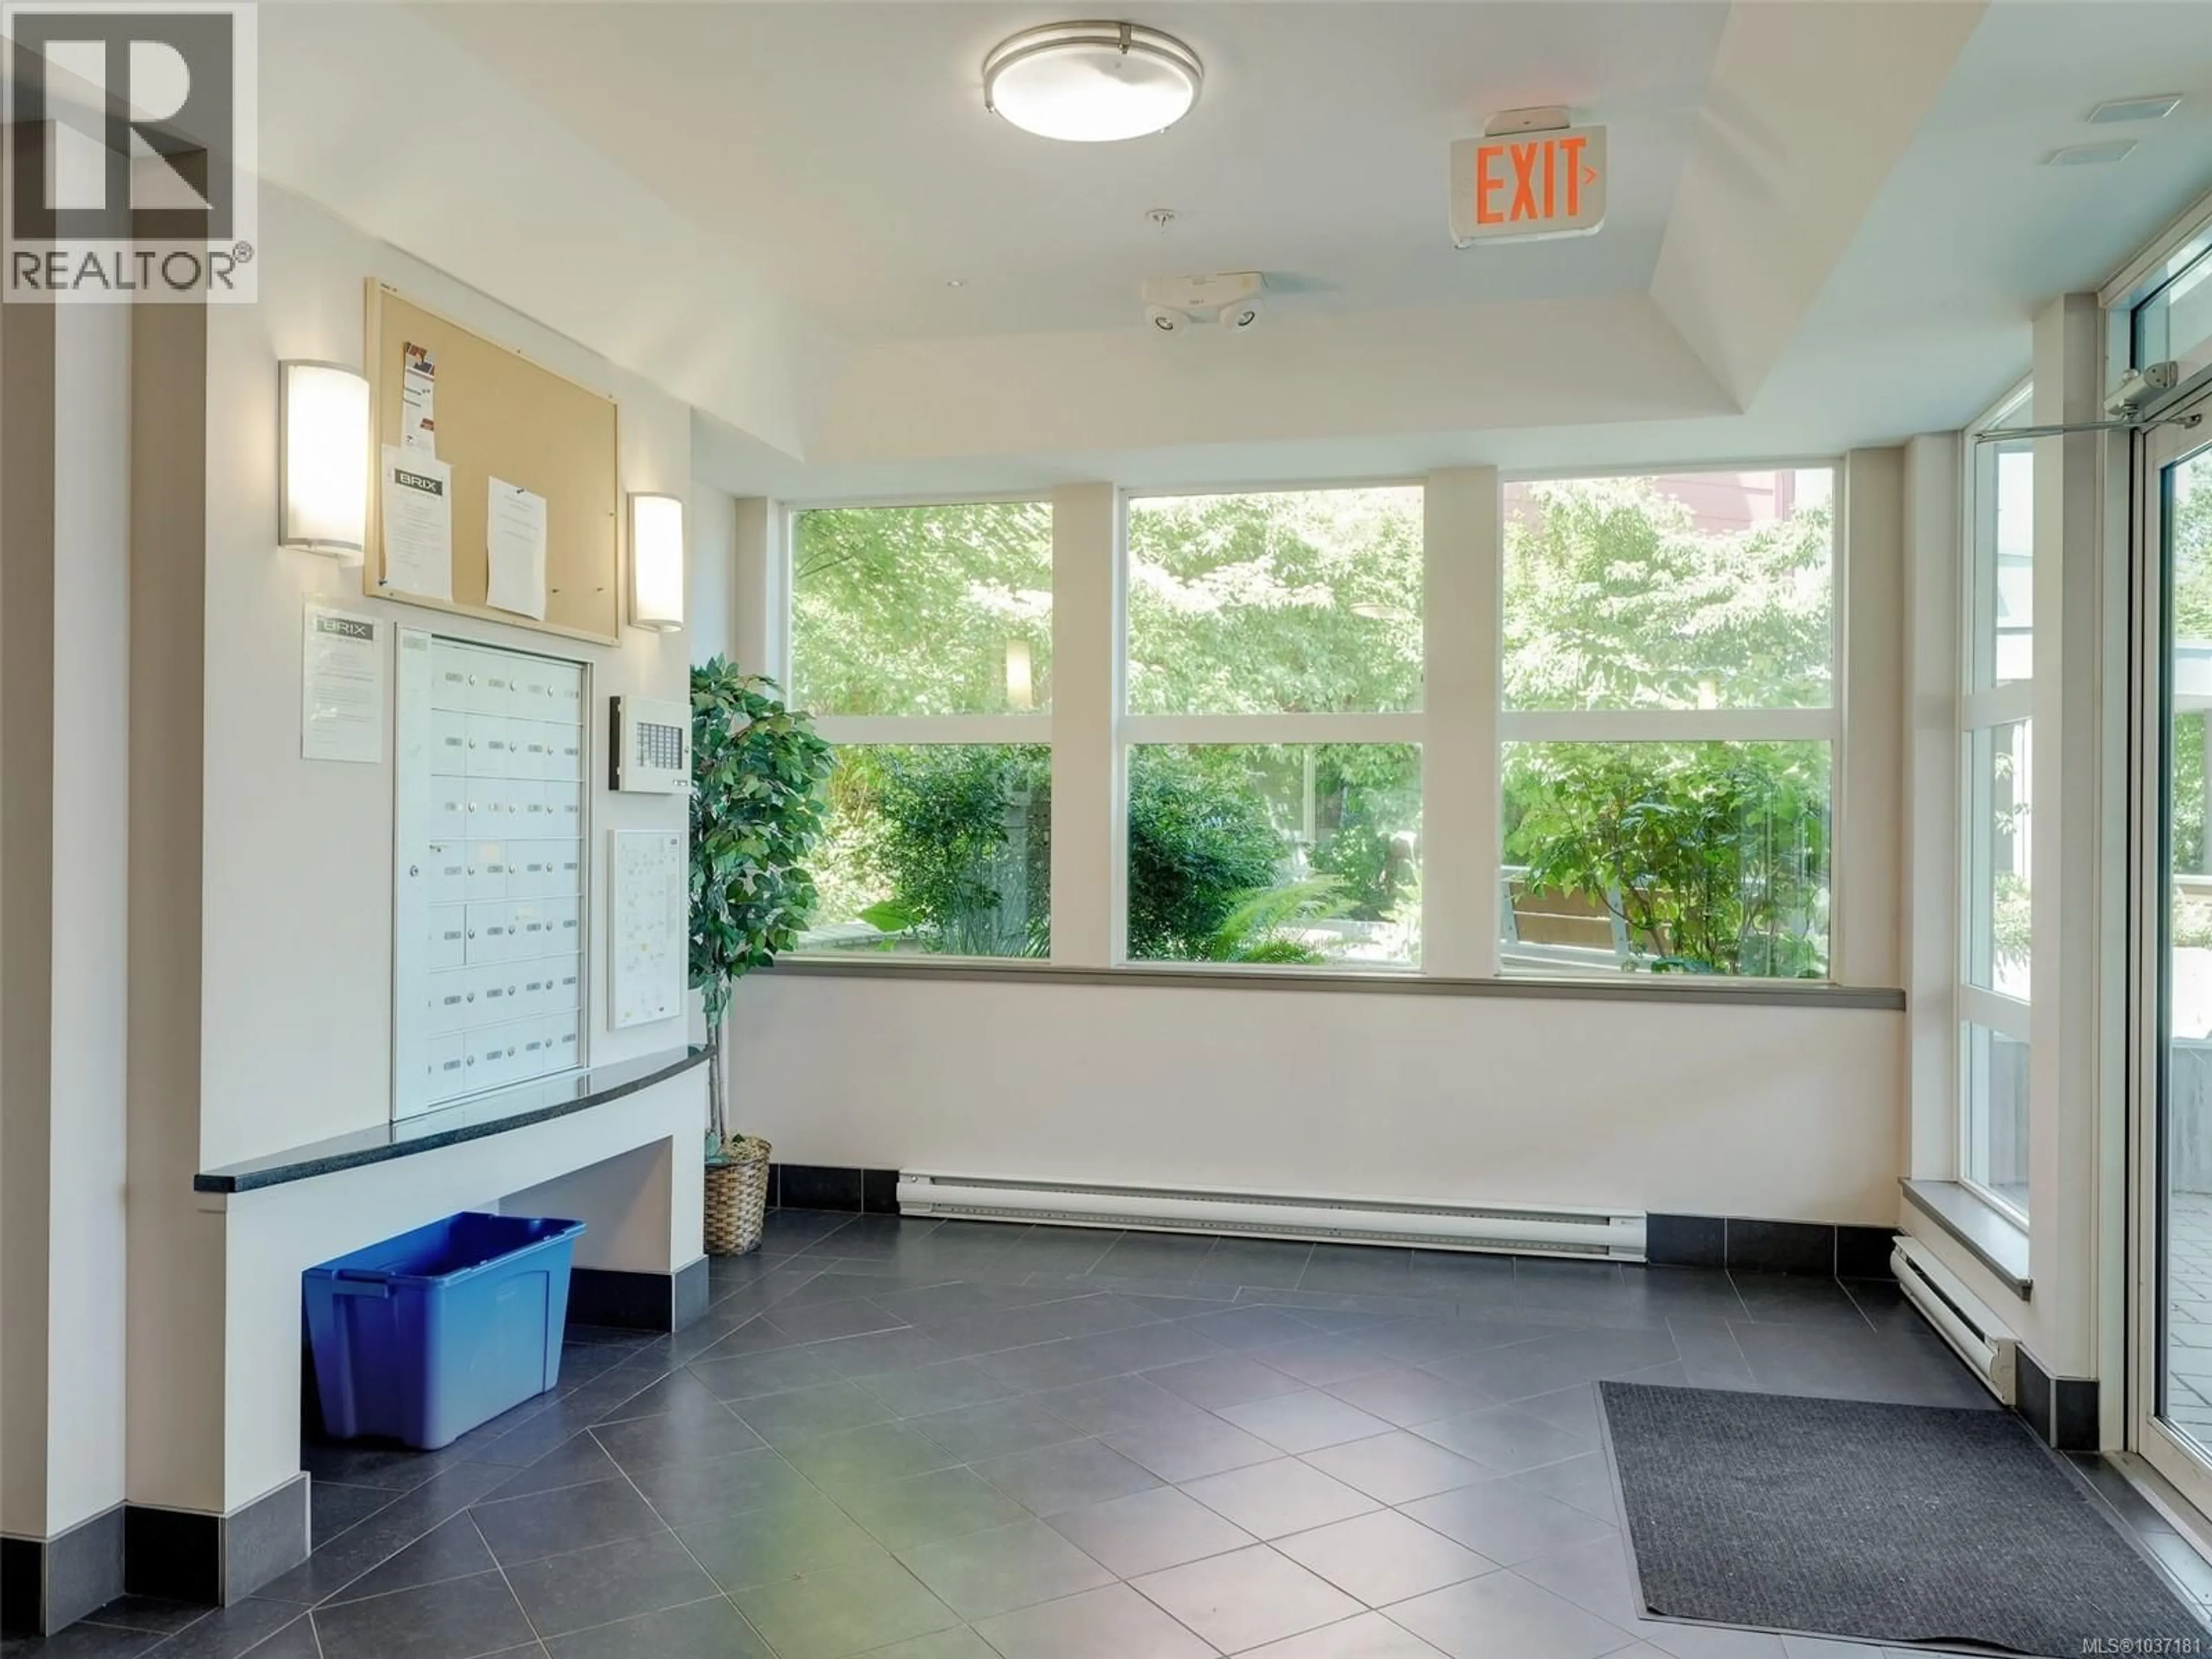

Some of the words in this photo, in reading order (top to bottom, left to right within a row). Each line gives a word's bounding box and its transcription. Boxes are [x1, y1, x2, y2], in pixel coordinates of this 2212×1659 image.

[1477, 137, 1586, 224] EXIT
[400, 473, 436, 492] BRIX
[324, 620, 366, 636] BRIX
